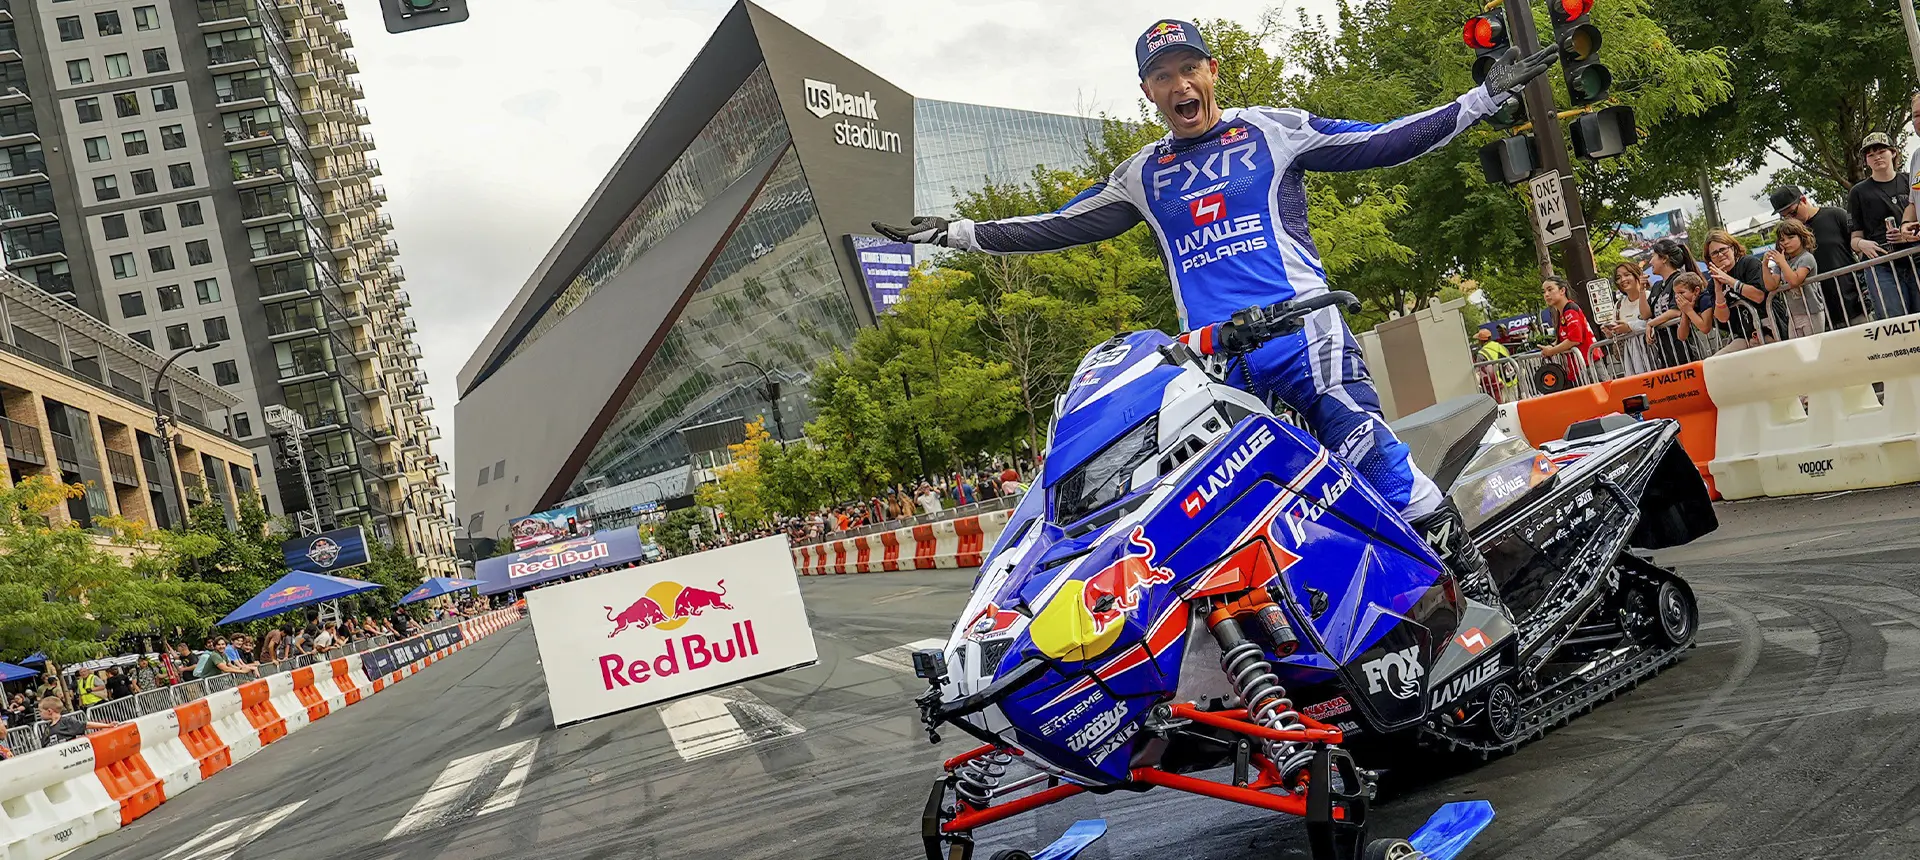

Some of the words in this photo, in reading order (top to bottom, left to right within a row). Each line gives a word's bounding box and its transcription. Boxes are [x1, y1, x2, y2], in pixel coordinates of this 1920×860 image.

[1147, 36, 1167, 53] Red
[1166, 33, 1187, 43] Bull
[834, 119, 902, 154] stadium
[1153, 141, 1257, 201] FXR
[1535, 178, 1557, 199] ONE
[1538, 196, 1562, 217] WAY
[1181, 236, 1268, 274] POLARIS
[1656, 368, 1697, 386] VALTIR
[1798, 458, 1834, 474] YODOCK
[510, 555, 560, 578] Red
[561, 543, 608, 567] Bull
[598, 638, 679, 691] Red
[681, 619, 759, 671] Bull
[1362, 644, 1425, 699] FOX
[1040, 689, 1104, 736] EXTREME
[1065, 713, 1104, 742] TEAM
[67, 742, 91, 755] VALTIR
[1087, 720, 1140, 768] FXR
